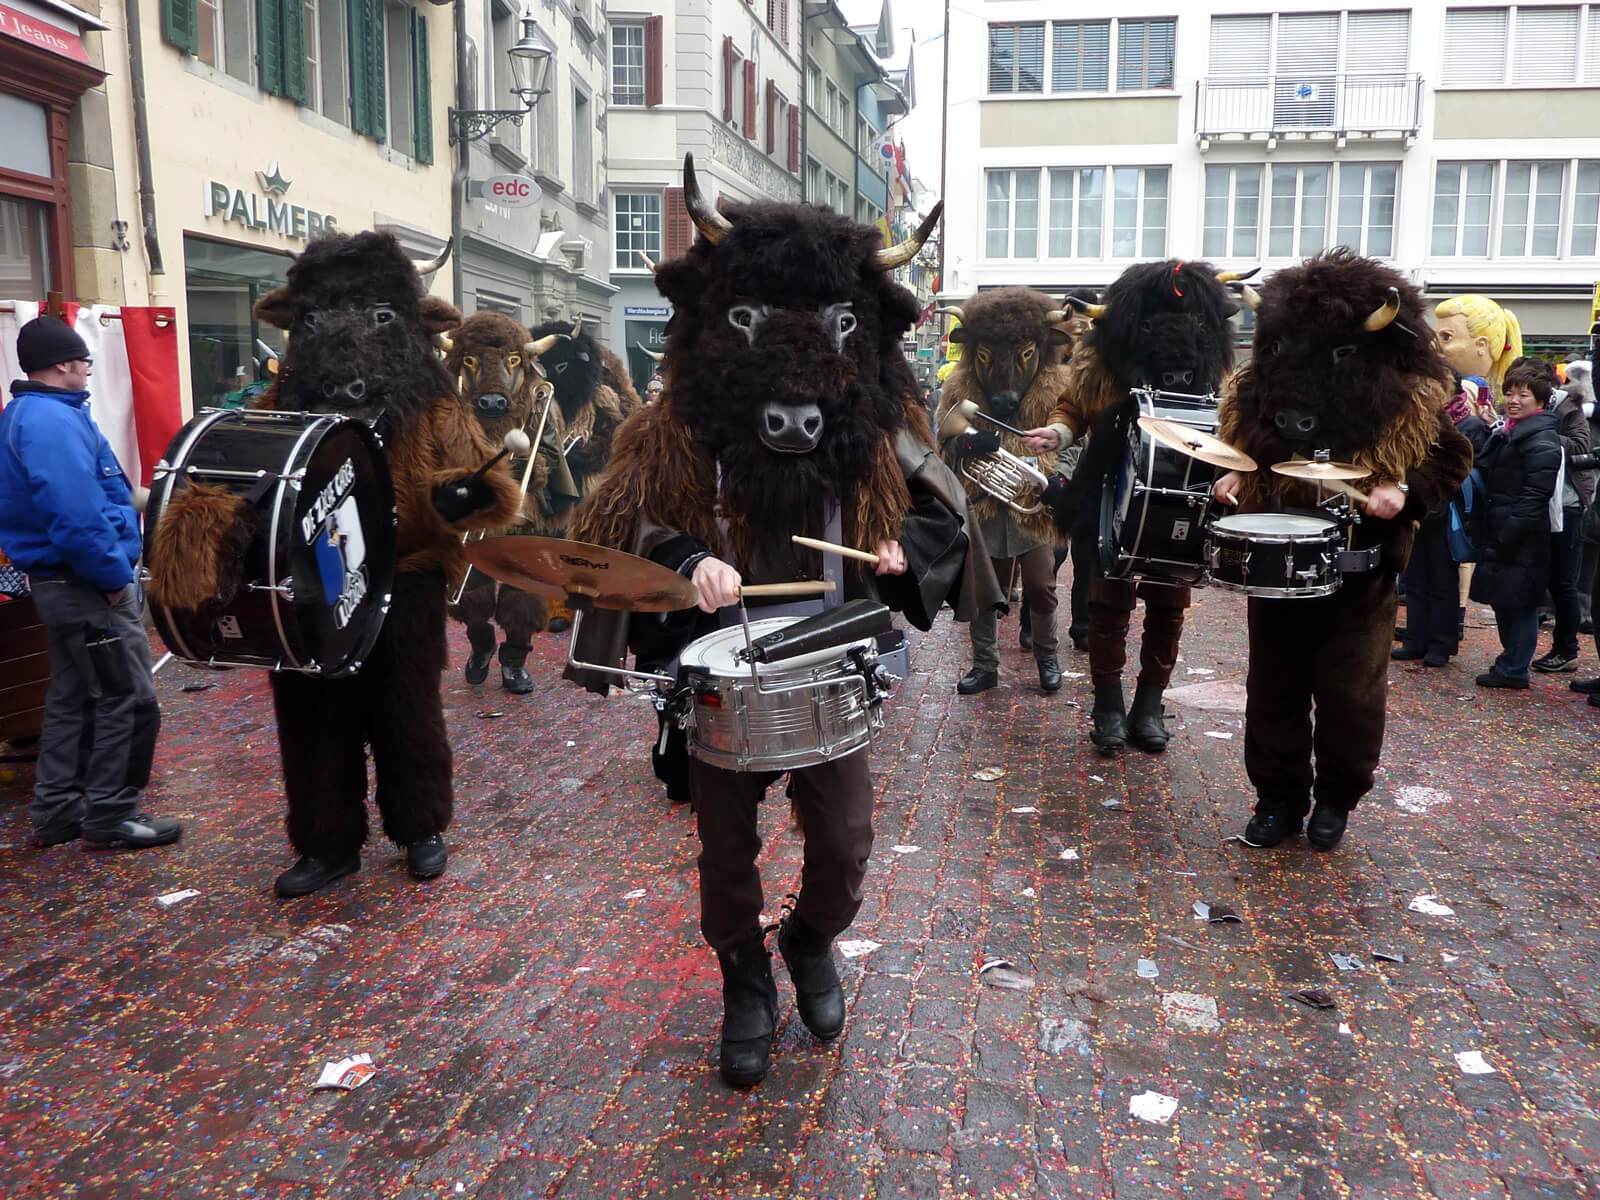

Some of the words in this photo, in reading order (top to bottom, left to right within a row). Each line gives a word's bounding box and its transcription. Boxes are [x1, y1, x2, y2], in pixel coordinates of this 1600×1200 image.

[12, 17, 69, 50] Jeans
[492, 179, 530, 197] edc
[203, 180, 338, 239] PALMERS
